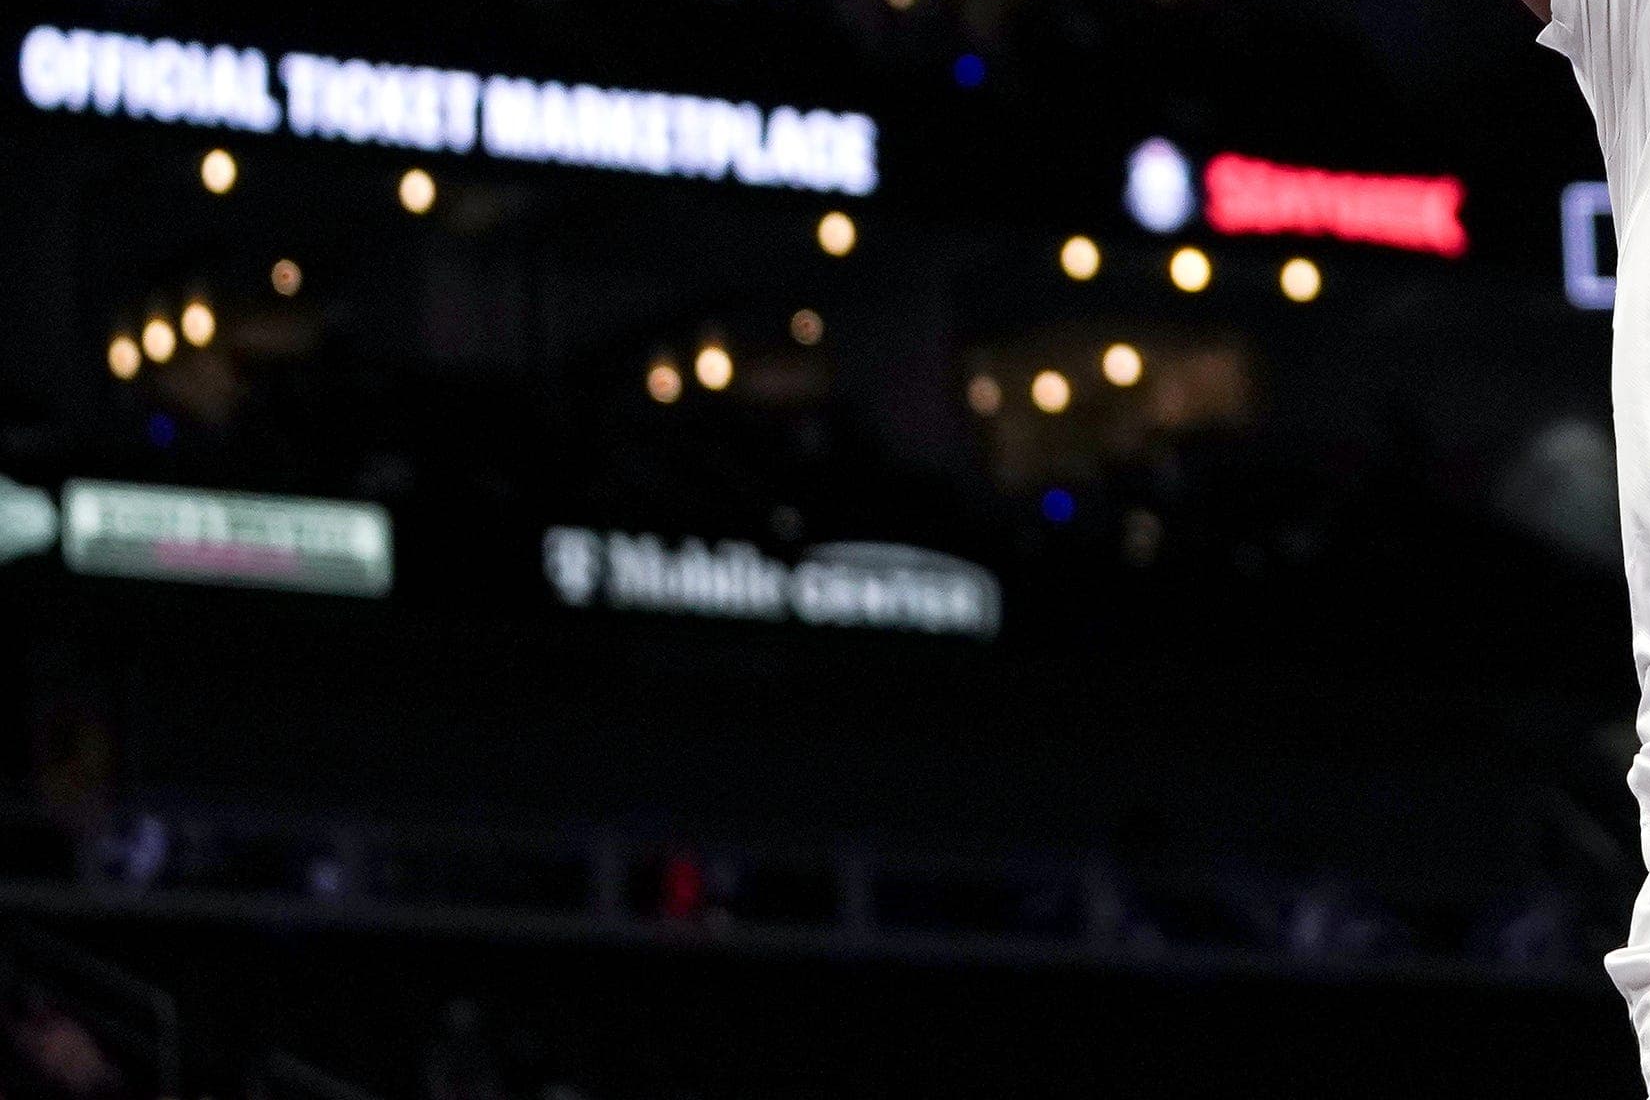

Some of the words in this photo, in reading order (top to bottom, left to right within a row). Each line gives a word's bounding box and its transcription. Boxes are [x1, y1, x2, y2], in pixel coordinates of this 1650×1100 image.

[22, 27, 279, 131] OFFICIAL
[281, 54, 479, 150] TICKET
[483, 77, 875, 194] MARKETPLACE
